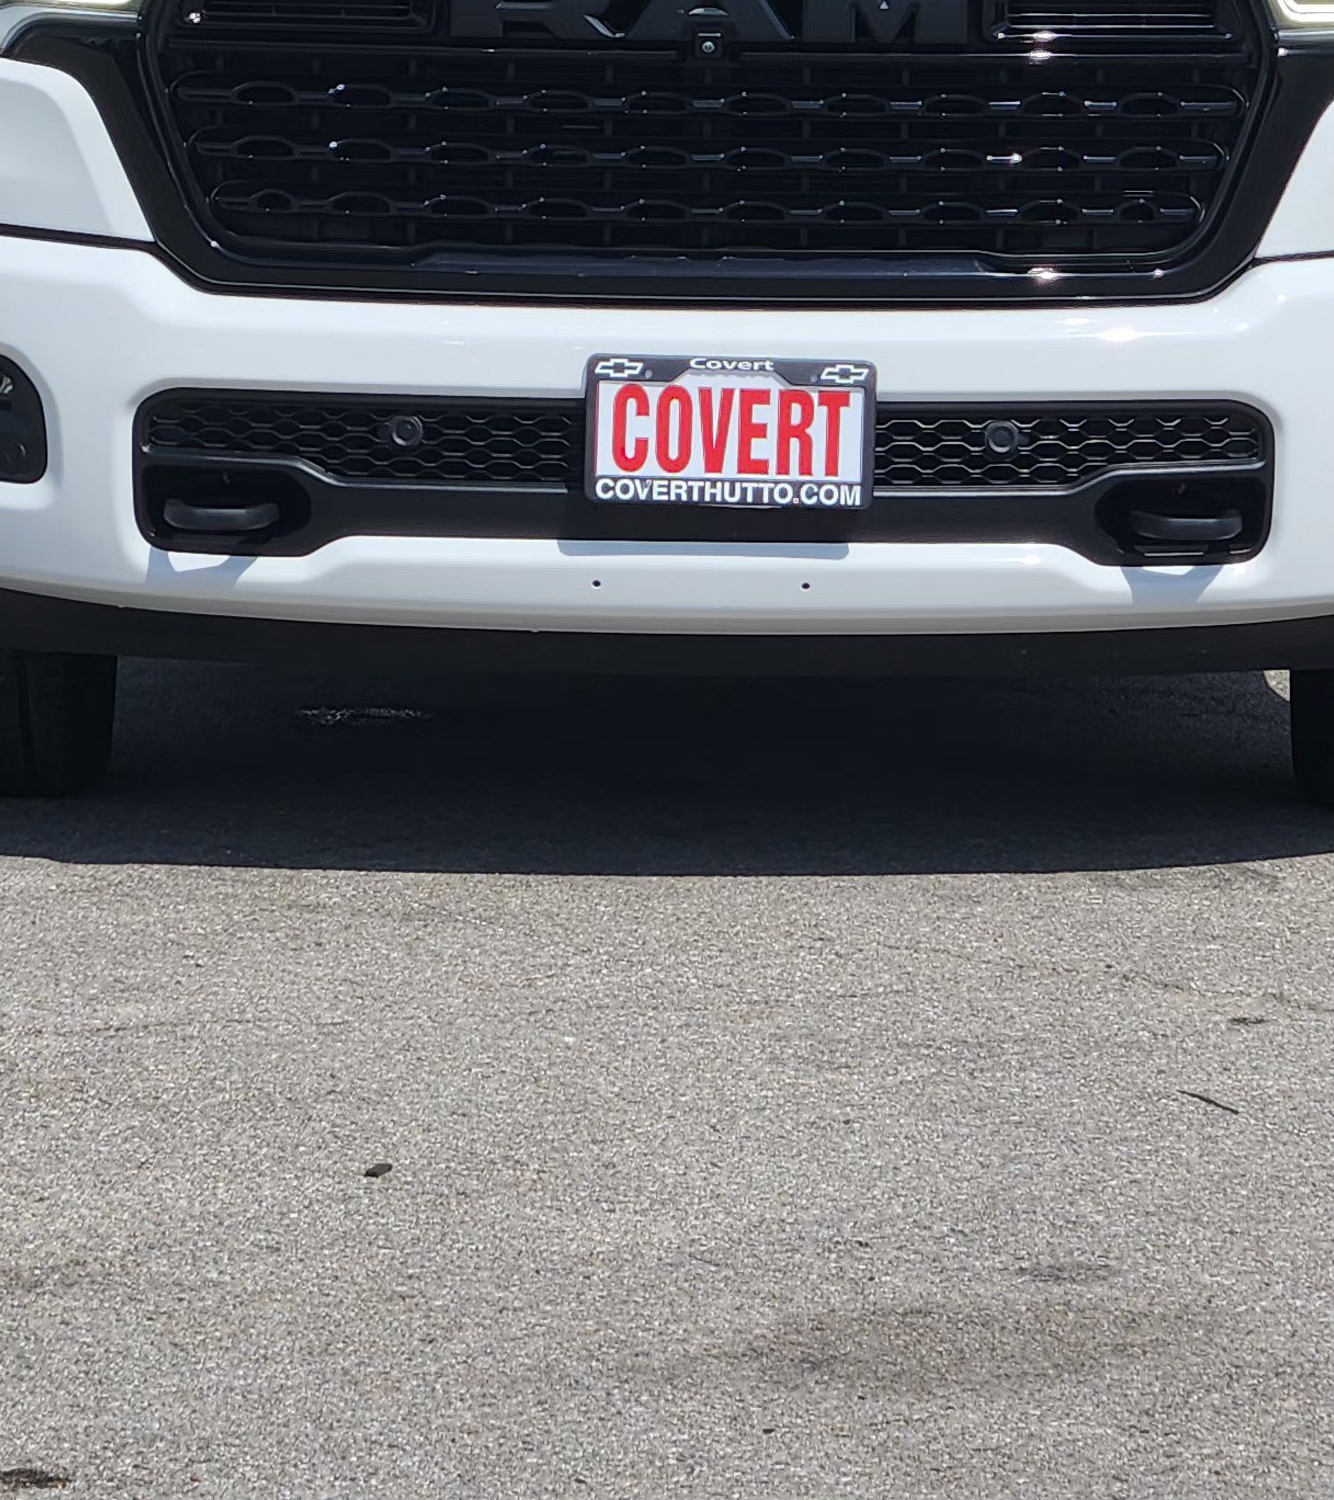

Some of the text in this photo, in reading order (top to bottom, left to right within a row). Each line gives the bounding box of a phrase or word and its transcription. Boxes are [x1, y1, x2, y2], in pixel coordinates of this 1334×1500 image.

[689, 357, 774, 372] Covert
[612, 383, 851, 477] COVERT
[595, 478, 861, 506] COVERTHUTTO.COM
